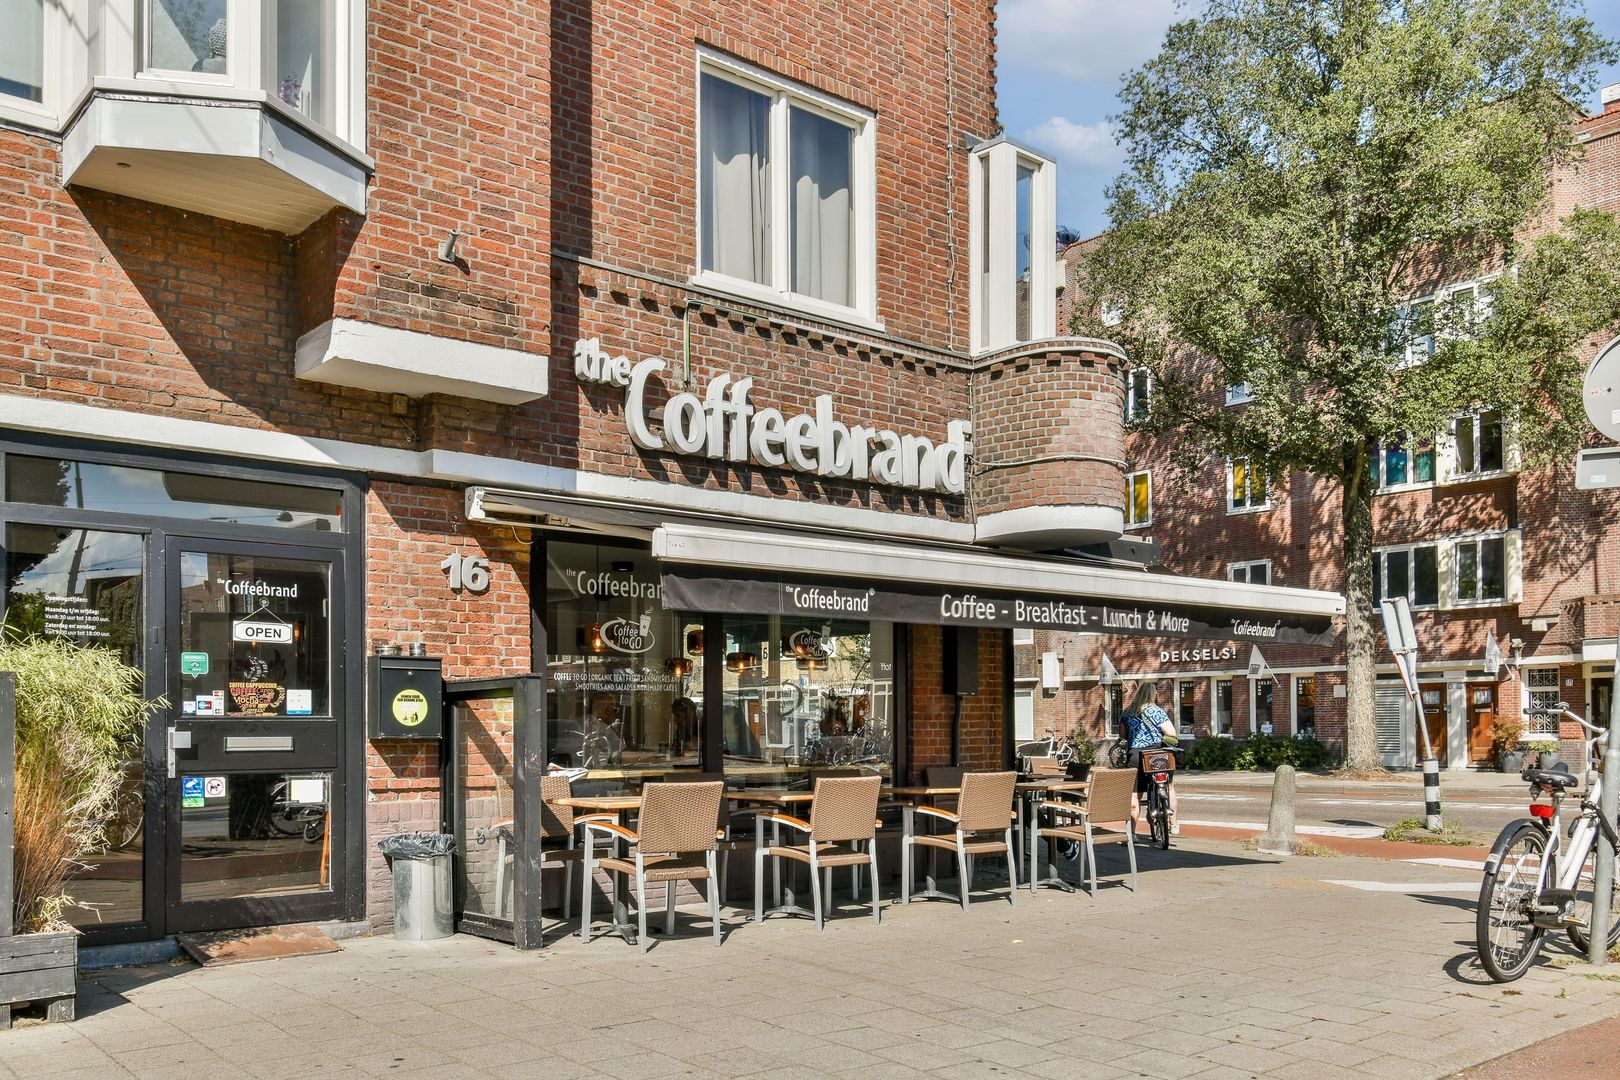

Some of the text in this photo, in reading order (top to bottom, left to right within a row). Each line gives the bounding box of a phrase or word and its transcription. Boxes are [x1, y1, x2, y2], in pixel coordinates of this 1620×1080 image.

[573, 337, 965, 496] the Coffeebrand
[441, 553, 490, 592] 16
[566, 568, 577, 577] the
[225, 580, 298, 598] Coffeebrand
[45, 606, 68, 614] Maandag
[940, 594, 996, 620] Coffee
[1015, 599, 1088, 626] Breakfast
[1102, 606, 1142, 629] Lunch
[1145, 610, 1157, 631] &
[1160, 611, 1190, 633] More
[245, 626, 282, 639] OPEN
[613, 624, 639, 637] Coffee
[621, 633, 642, 650] to GO
[1160, 647, 1237, 663] DEKSELS!
[554, 672, 573, 681] COFFEE
[573, 673, 580, 681] TO
[580, 673, 588, 681] GO
[591, 673, 613, 682] ORGANIC
[575, 683, 604, 691] SMOOTHIES
[604, 683, 614, 691] AND
[233, 695, 259, 705] Mocha
